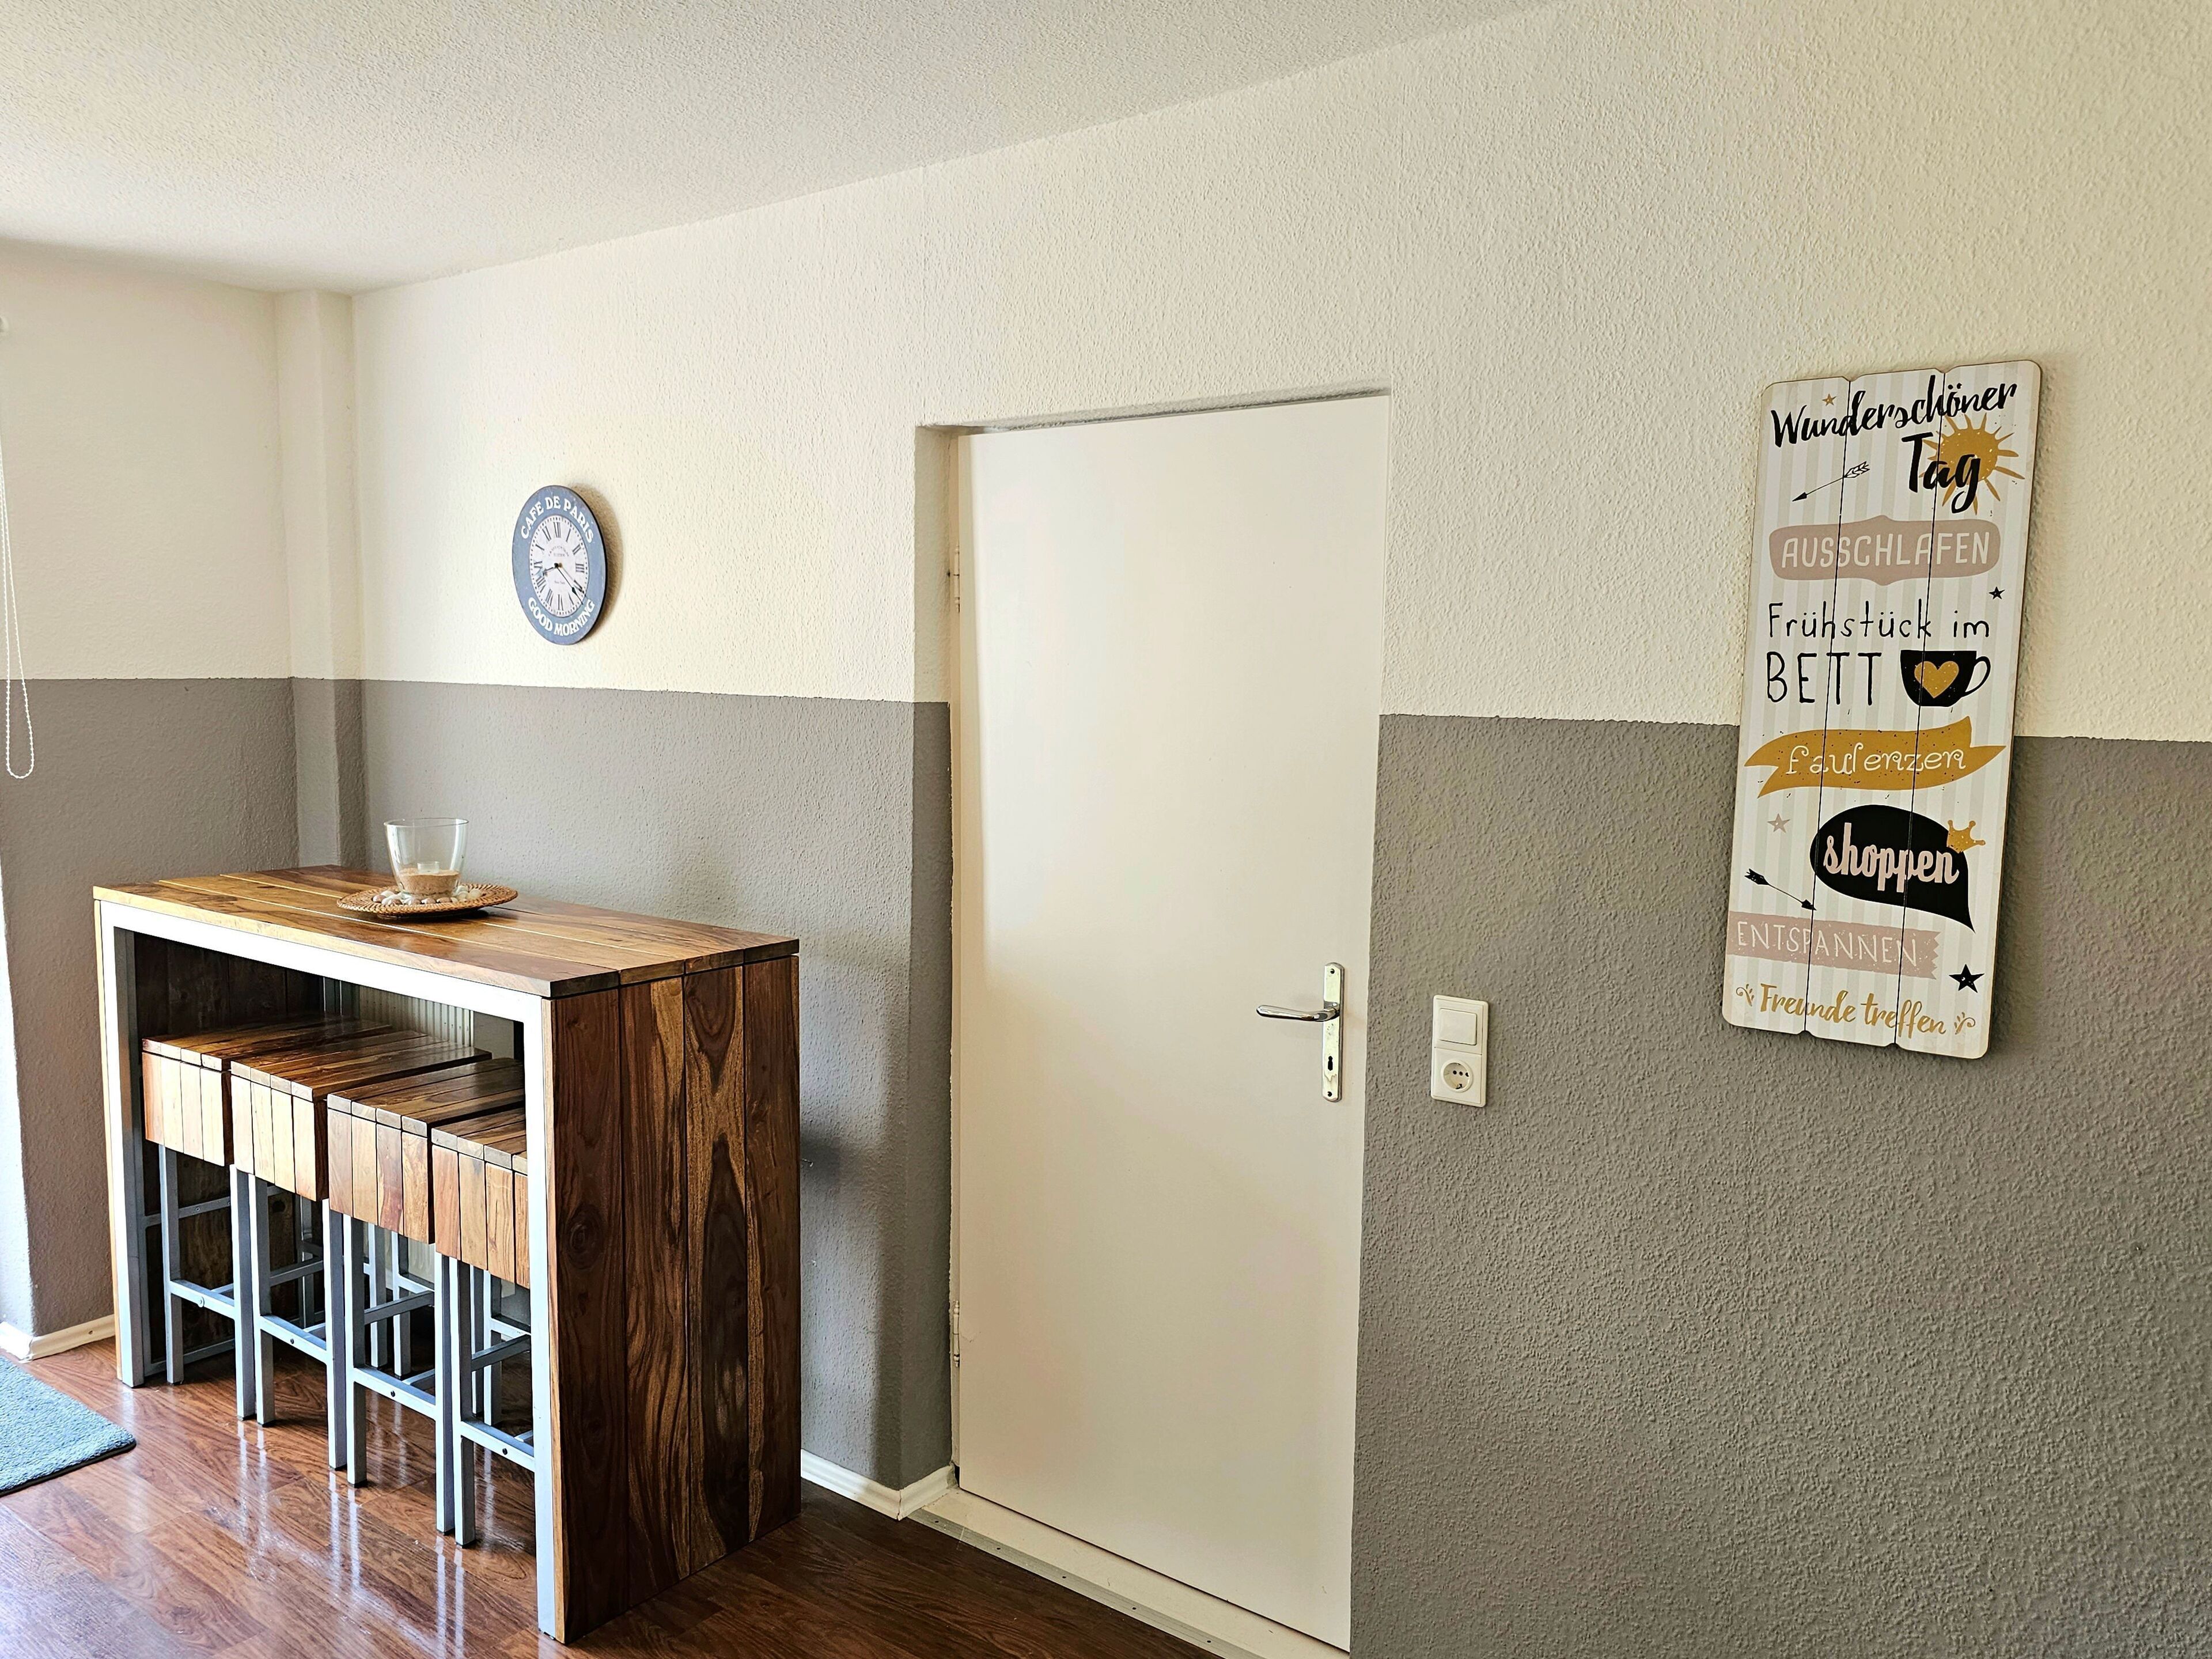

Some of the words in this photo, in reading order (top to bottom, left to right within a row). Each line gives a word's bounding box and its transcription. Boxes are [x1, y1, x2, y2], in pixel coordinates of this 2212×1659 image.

[1771, 374, 2017, 448] Wunderschöner
[1902, 432, 1982, 514] Tag
[521, 502, 544, 539] CAFE
[545, 495, 561, 509] DE
[564, 498, 594, 543] PARIS
[1781, 531, 1990, 568] AUSSCHLAFEN
[528, 597, 553, 631] GOOD
[554, 599, 595, 637] MORNING
[1768, 599, 1931, 638] Frühstück
[1953, 610, 1990, 637] im
[1767, 651, 1882, 706] BETT
[1786, 742, 1966, 775] faulenzen
[1823, 822, 1960, 893] shoppen
[1737, 921, 1917, 967] ENTSPANNEN
[1760, 983, 1856, 1023] Freunde
[1861, 993, 1946, 1038] treffen
